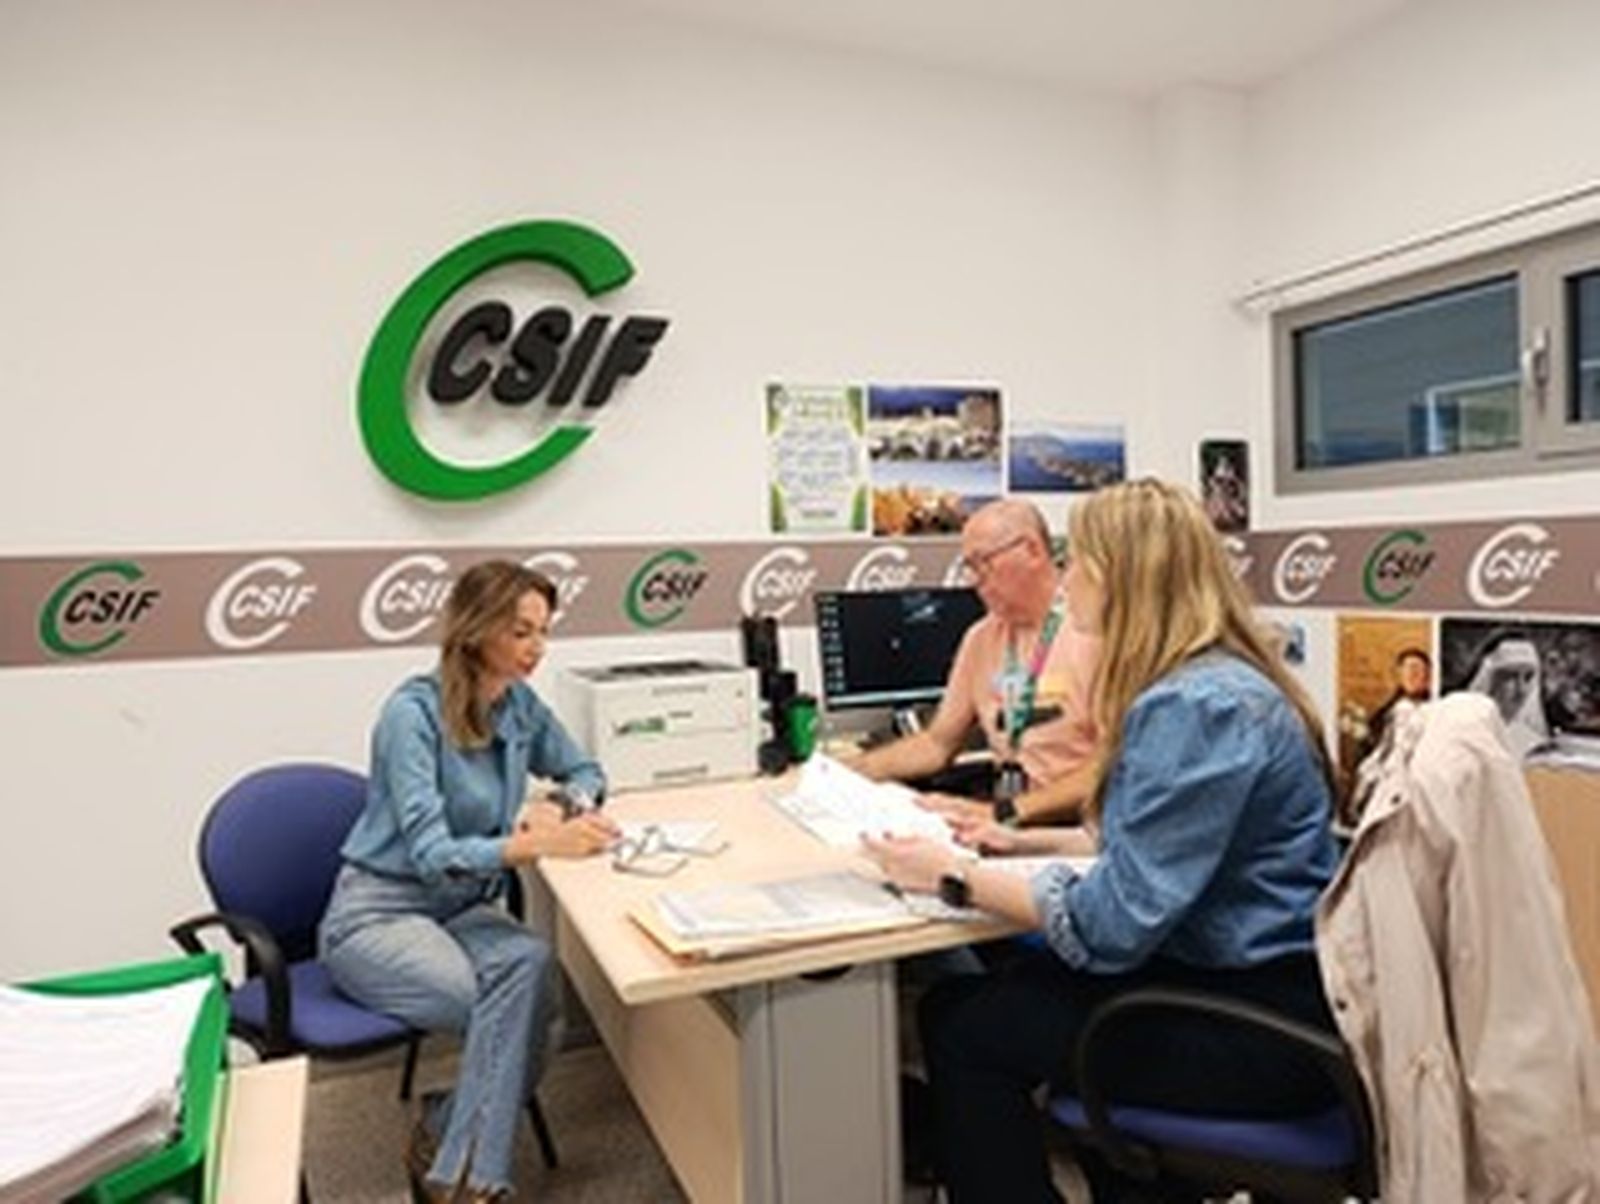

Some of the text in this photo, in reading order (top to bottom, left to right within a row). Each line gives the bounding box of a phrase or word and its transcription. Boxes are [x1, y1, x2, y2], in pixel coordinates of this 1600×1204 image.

[427, 301, 670, 408] CSIF
[1378, 551, 1436, 580] CSIF
[1484, 547, 1562, 582] CSIF
[642, 570, 707, 602] CSIF
[757, 569, 818, 599] CSIF
[64, 590, 160, 624] CSIF
[229, 584, 317, 619] CSIF
